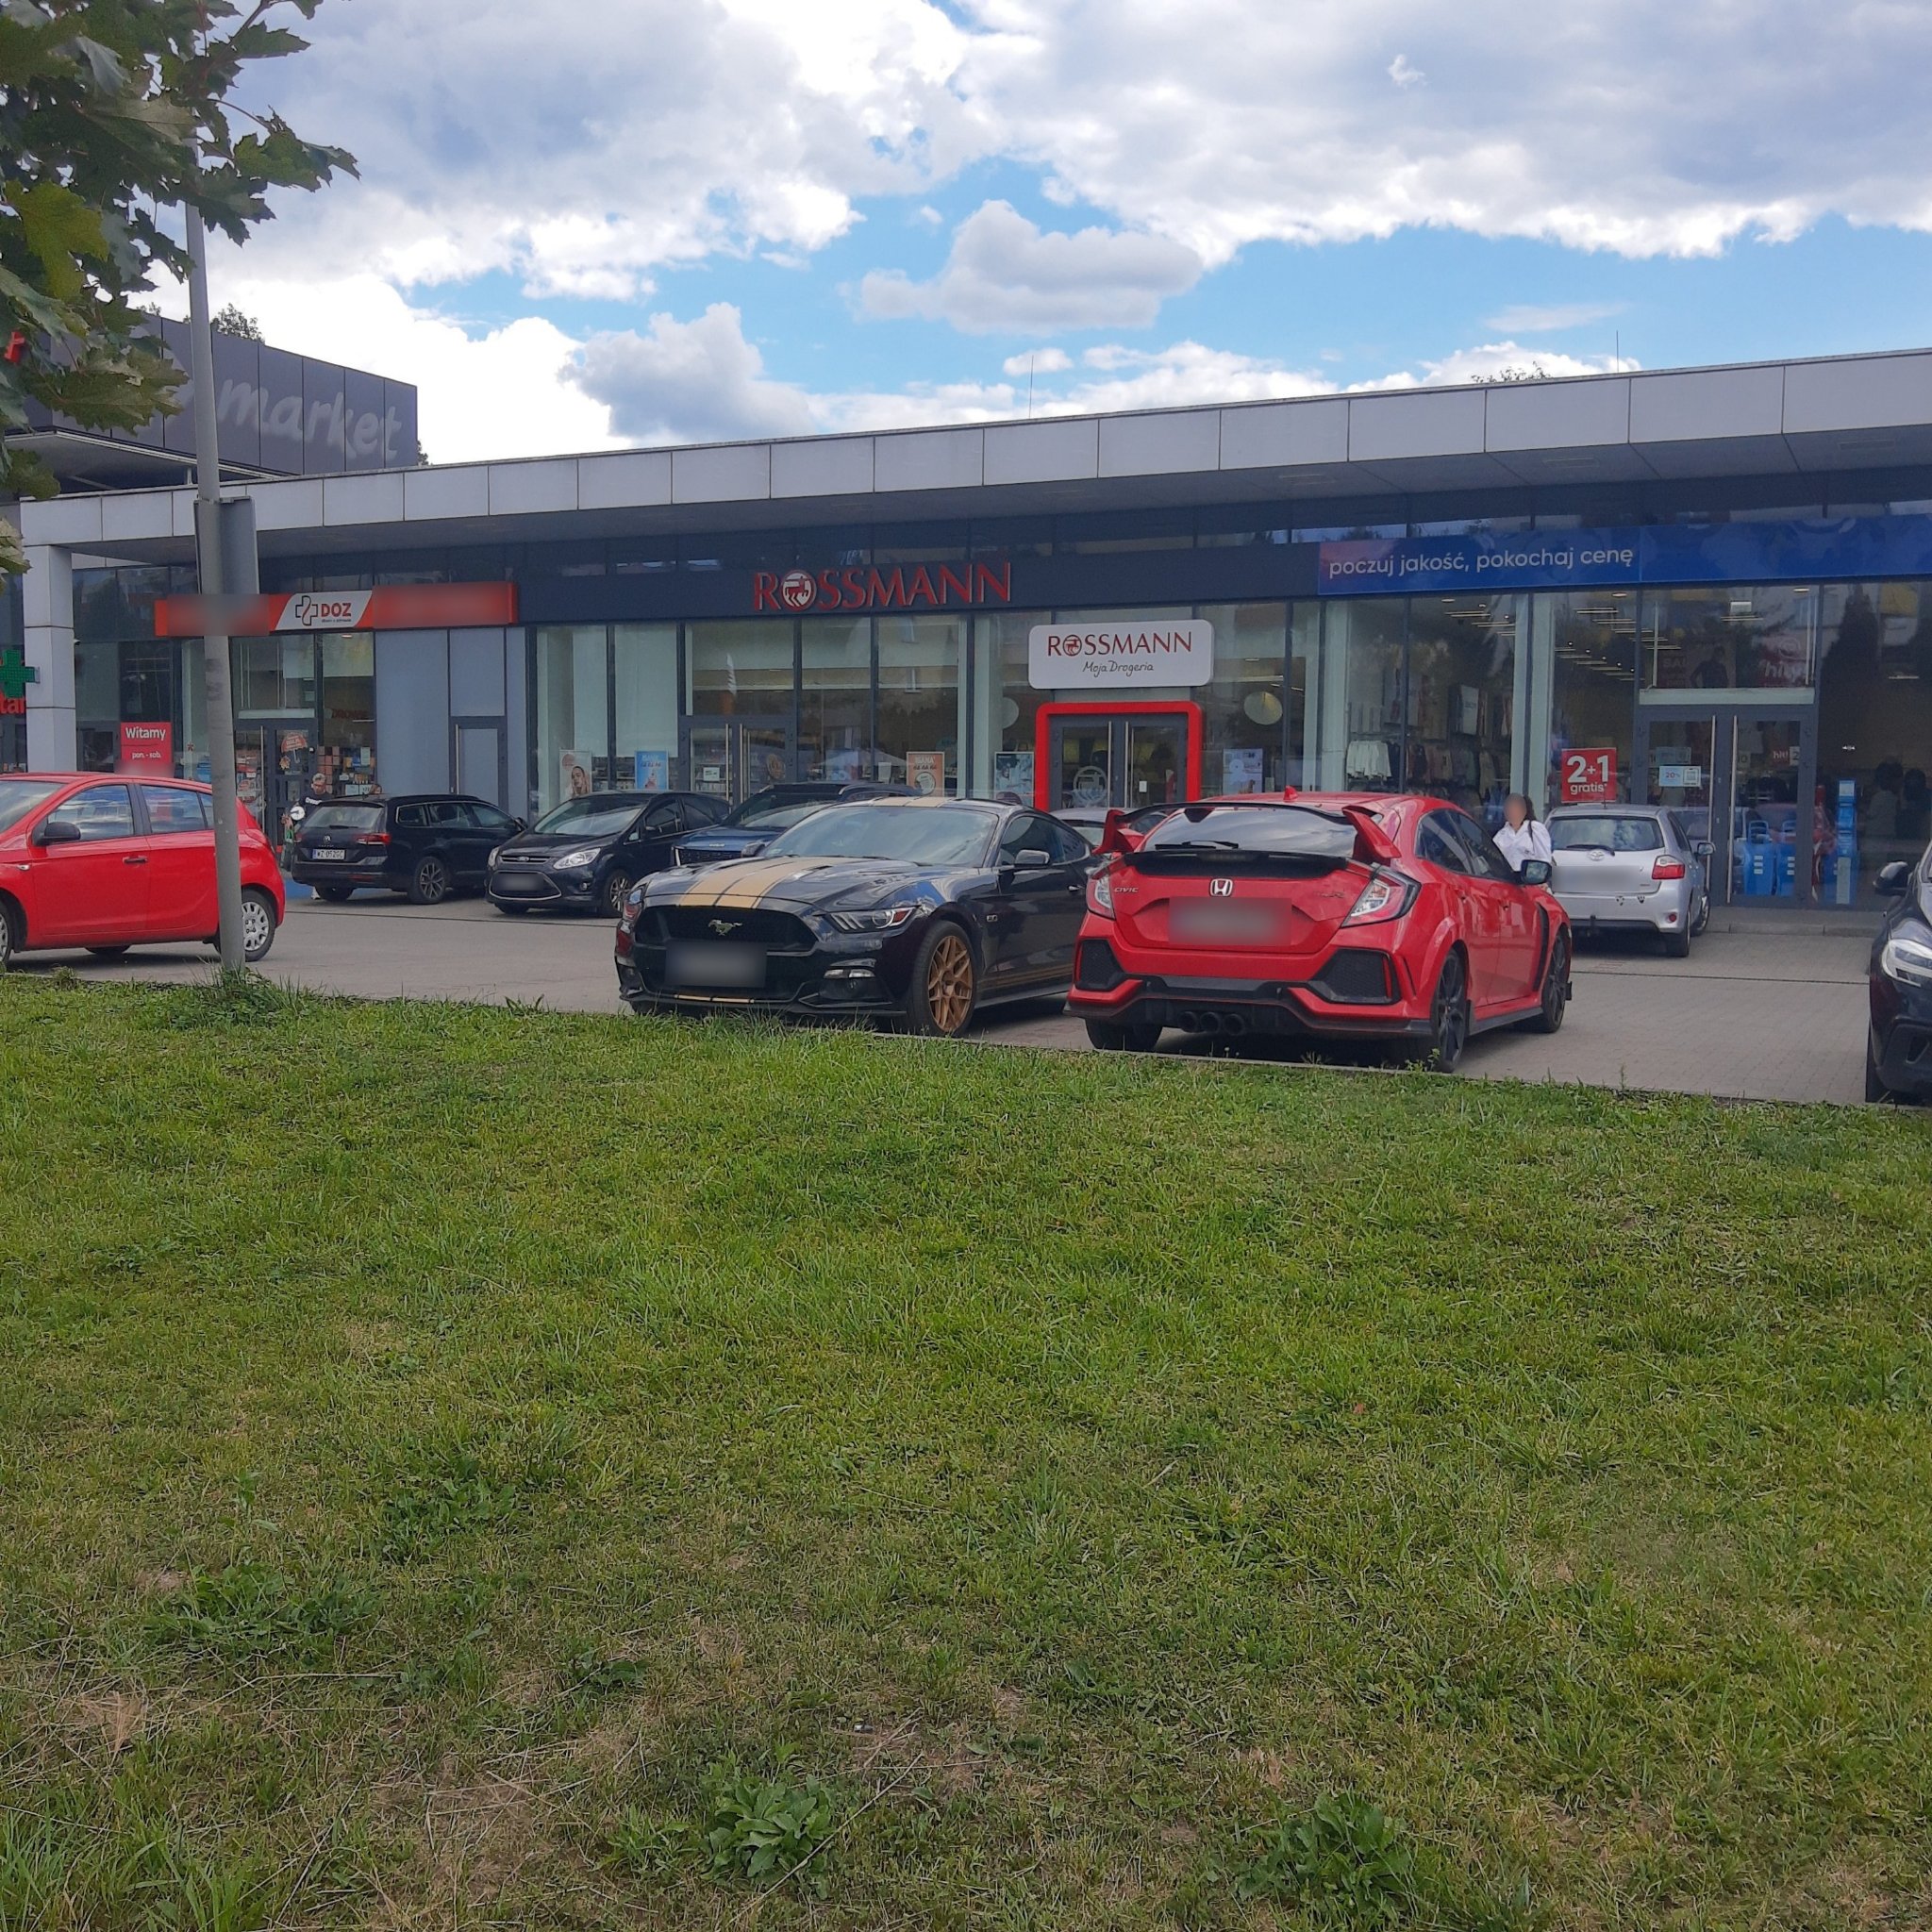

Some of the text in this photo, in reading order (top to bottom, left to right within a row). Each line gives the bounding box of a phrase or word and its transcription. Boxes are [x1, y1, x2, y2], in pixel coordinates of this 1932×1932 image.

[216, 378, 402, 461] market
[1329, 547, 1634, 579] poczuj jakość, pokochaj cenę
[755, 561, 1011, 611] ROSSMANN
[321, 603, 352, 617] DOZ
[1048, 631, 1192, 657] ROSSMANN
[1083, 660, 1154, 677] Moja Drogeria
[125, 726, 166, 741] Witamy
[1567, 755, 1608, 783] 2+1
